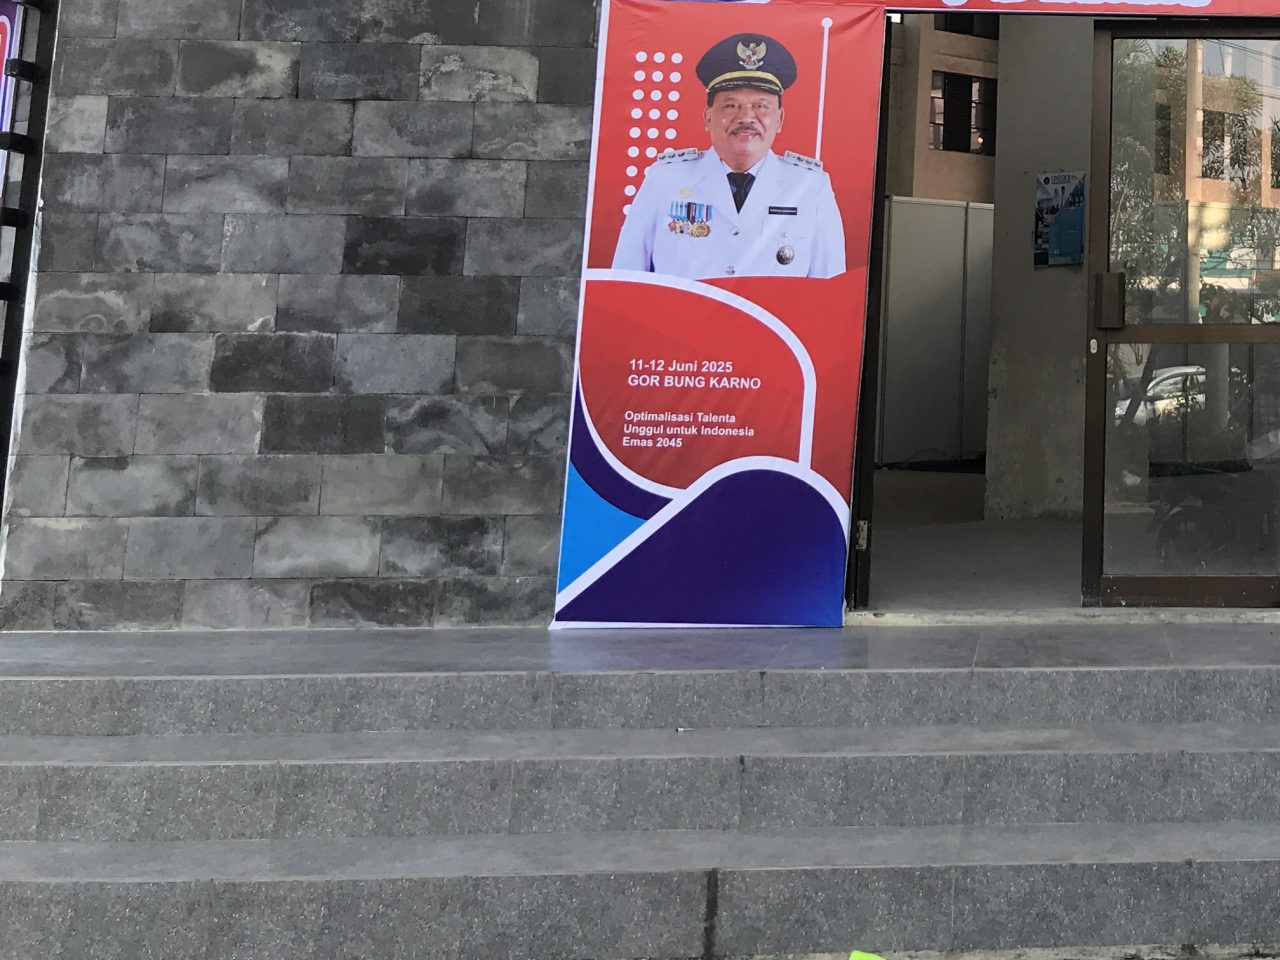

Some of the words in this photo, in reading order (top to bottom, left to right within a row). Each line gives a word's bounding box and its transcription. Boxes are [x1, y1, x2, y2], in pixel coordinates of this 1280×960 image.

[629, 359, 665, 371] 11-12
[668, 360, 697, 372] Juni
[701, 361, 733, 373] 2025
[628, 375, 660, 387] GOR
[664, 376, 705, 388] BUNG
[709, 377, 761, 389] KARNO
[624, 410, 693, 425] Optimalisasi
[697, 412, 736, 423] Talenta
[623, 424, 664, 436] Unggul
[666, 425, 698, 435] untuk
[701, 426, 755, 437] Indonesia
[622, 436, 653, 447] Emas
[656, 437, 682, 448] 2045
